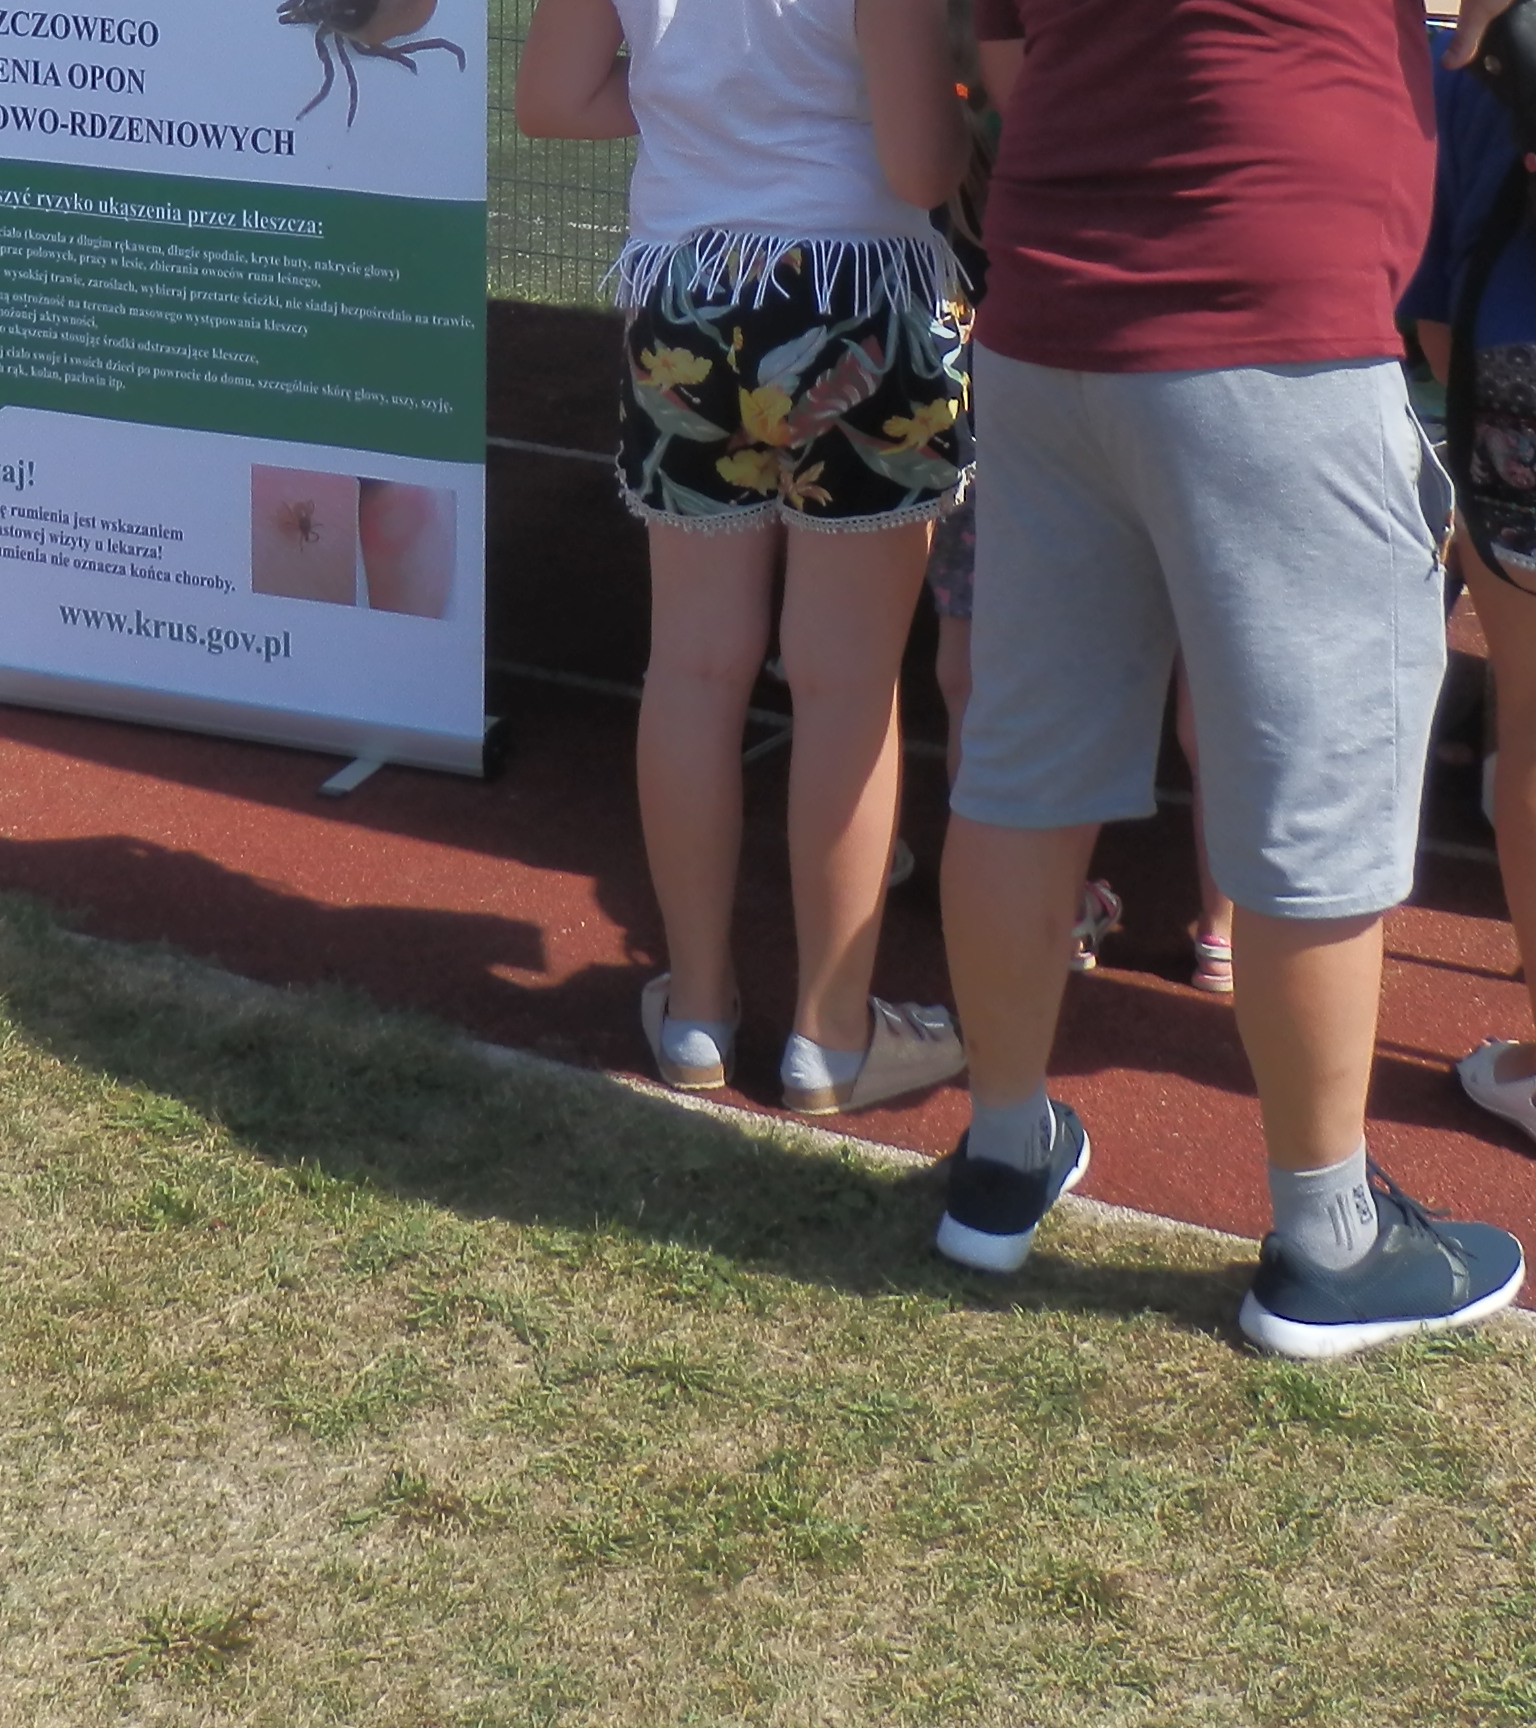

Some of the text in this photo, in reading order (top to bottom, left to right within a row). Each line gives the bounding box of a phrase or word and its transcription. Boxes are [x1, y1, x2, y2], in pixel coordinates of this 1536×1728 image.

[68, 62, 146, 95] OPON
[36, 192, 93, 212] ryzyko
[98, 196, 182, 222] ukąszenia
[188, 208, 236, 228] przez
[242, 209, 323, 235] kleszcza:
[26, 246, 77, 263] polowych,
[79, 253, 107, 268] pracy
[149, 261, 199, 277] zbierania
[248, 272, 274, 283] runa
[277, 271, 322, 288] leśnego,
[115, 240, 165, 257] rękawem,
[203, 248, 248, 264] spodnie,
[251, 252, 280, 270] kryte
[314, 259, 362, 275] nakrycie
[50, 273, 86, 288] trawie,
[87, 277, 138, 294] zaroślach,
[140, 284, 187, 300] wybieraj
[190, 289, 239, 304] przetarte
[242, 292, 283, 308] ścieżki,
[285, 299, 302, 310] nie
[305, 299, 338, 316] siadaj
[341, 302, 412, 322] bezpośrednio
[415, 314, 429, 324] na
[432, 314, 475, 330] trawie,
[128, 306, 182, 323] masowego
[185, 312, 261, 332] występowania
[264, 319, 308, 338] kleszczy
[102, 334, 135, 350] środki
[137, 340, 208, 362] odstraszające
[212, 347, 260, 365] kleszcze,
[137, 365, 151, 378] po
[153, 366, 200, 384] powrocie
[204, 370, 217, 383] do
[220, 373, 254, 388] domu,
[257, 378, 319, 396] szczególnie
[322, 384, 352, 401] skórę
[354, 388, 389, 404] głowy,
[10, 506, 70, 526] rumienia
[72, 511, 96, 530] jest
[100, 516, 185, 541] wskazaniem
[49, 528, 90, 553] wizyty
[94, 538, 103, 551] u
[107, 533, 163, 560] lekarza!
[50, 551, 70, 568] nie
[73, 556, 126, 576] oznacza
[129, 563, 171, 584] końca
[174, 570, 236, 593] choroby.
[59, 603, 292, 663] www.krus.gov.pl
